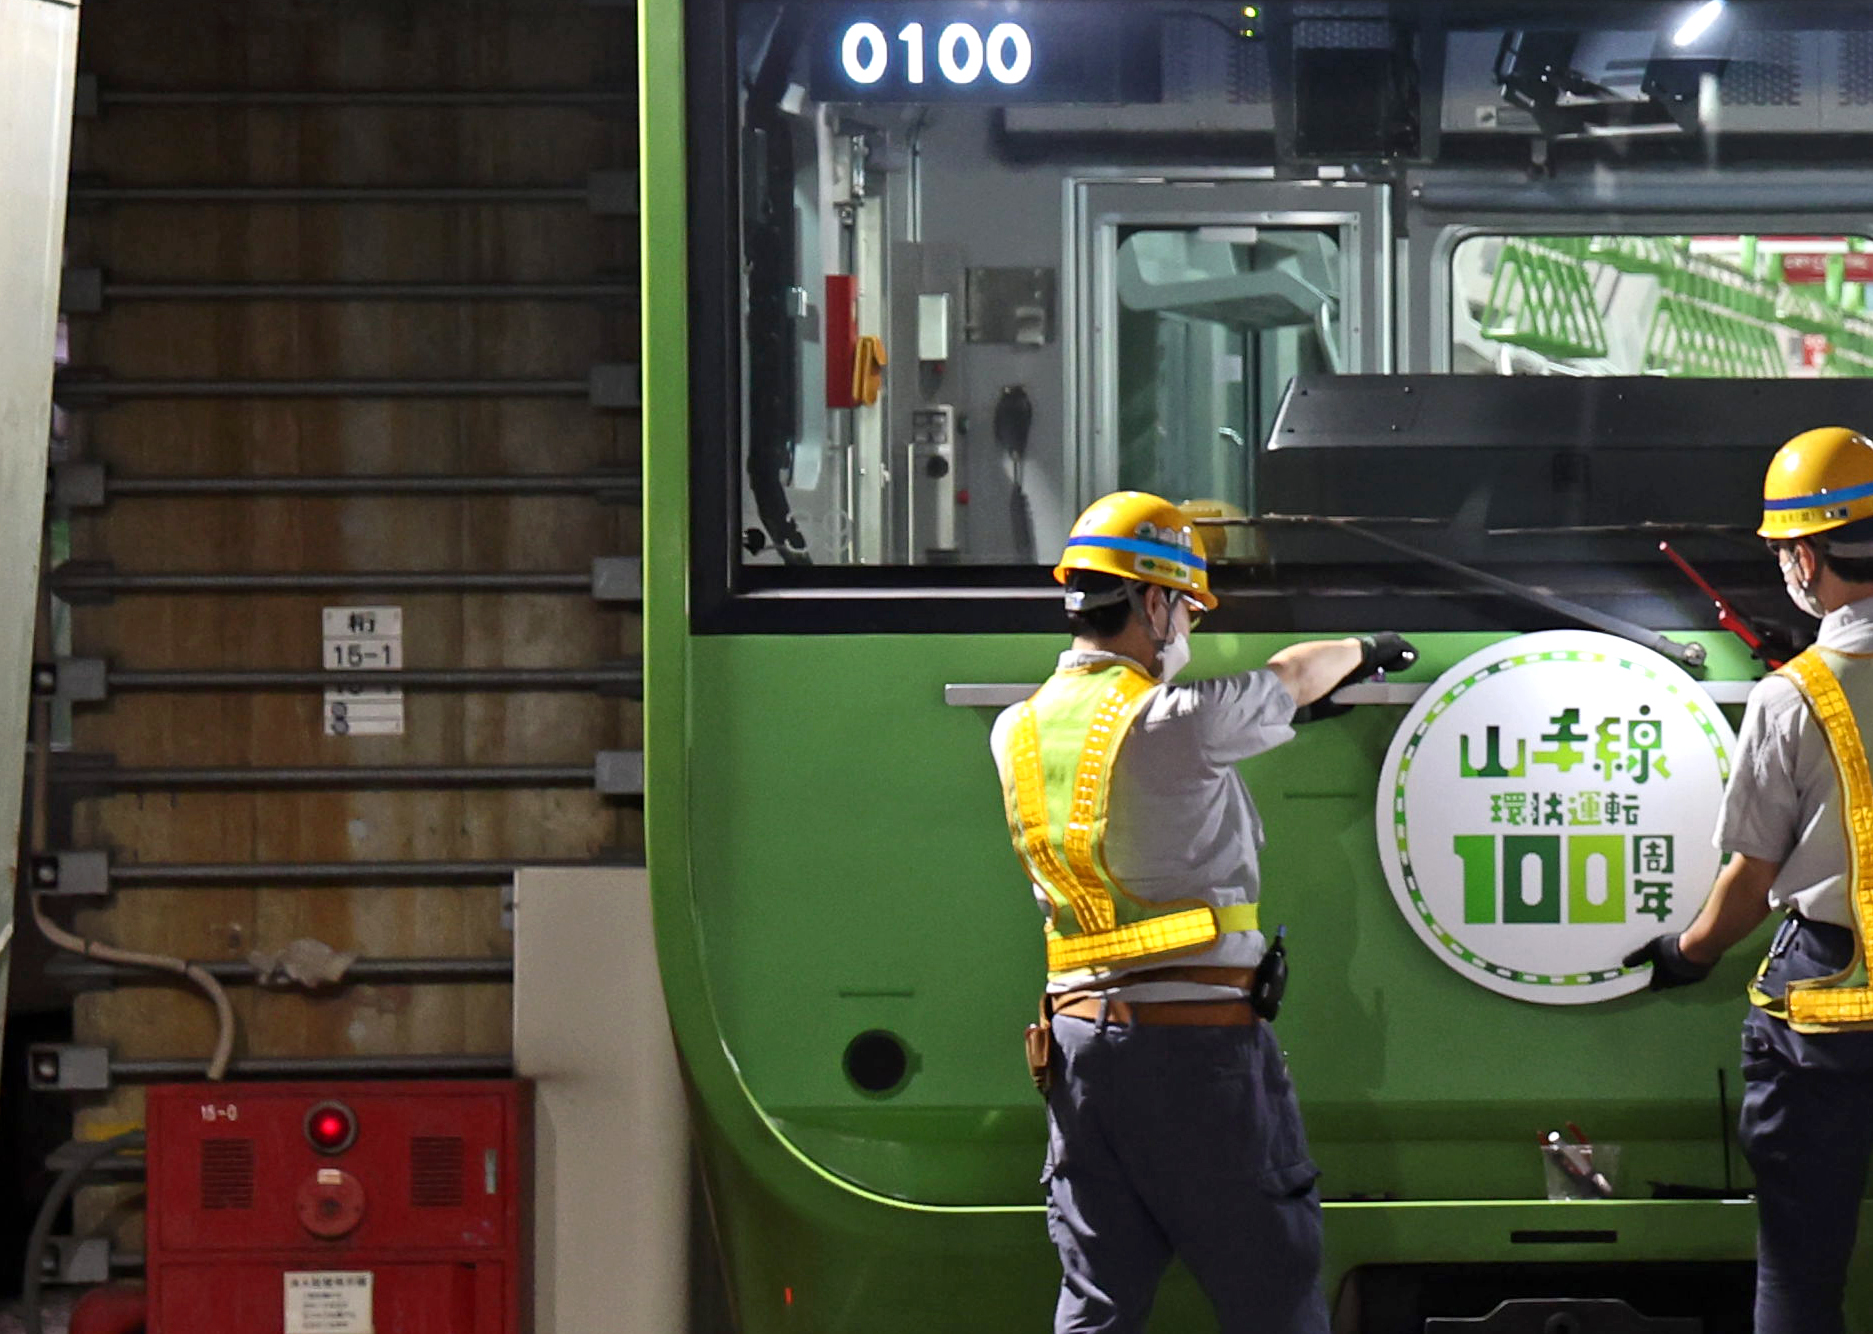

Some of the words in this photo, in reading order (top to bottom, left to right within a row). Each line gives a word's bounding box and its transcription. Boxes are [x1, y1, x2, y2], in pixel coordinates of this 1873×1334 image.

[842, 22, 1032, 84] 0100
[334, 643, 391, 666] 15-1
[1460, 705, 1671, 784] 山手線
[1490, 792, 1640, 825] 環状運転
